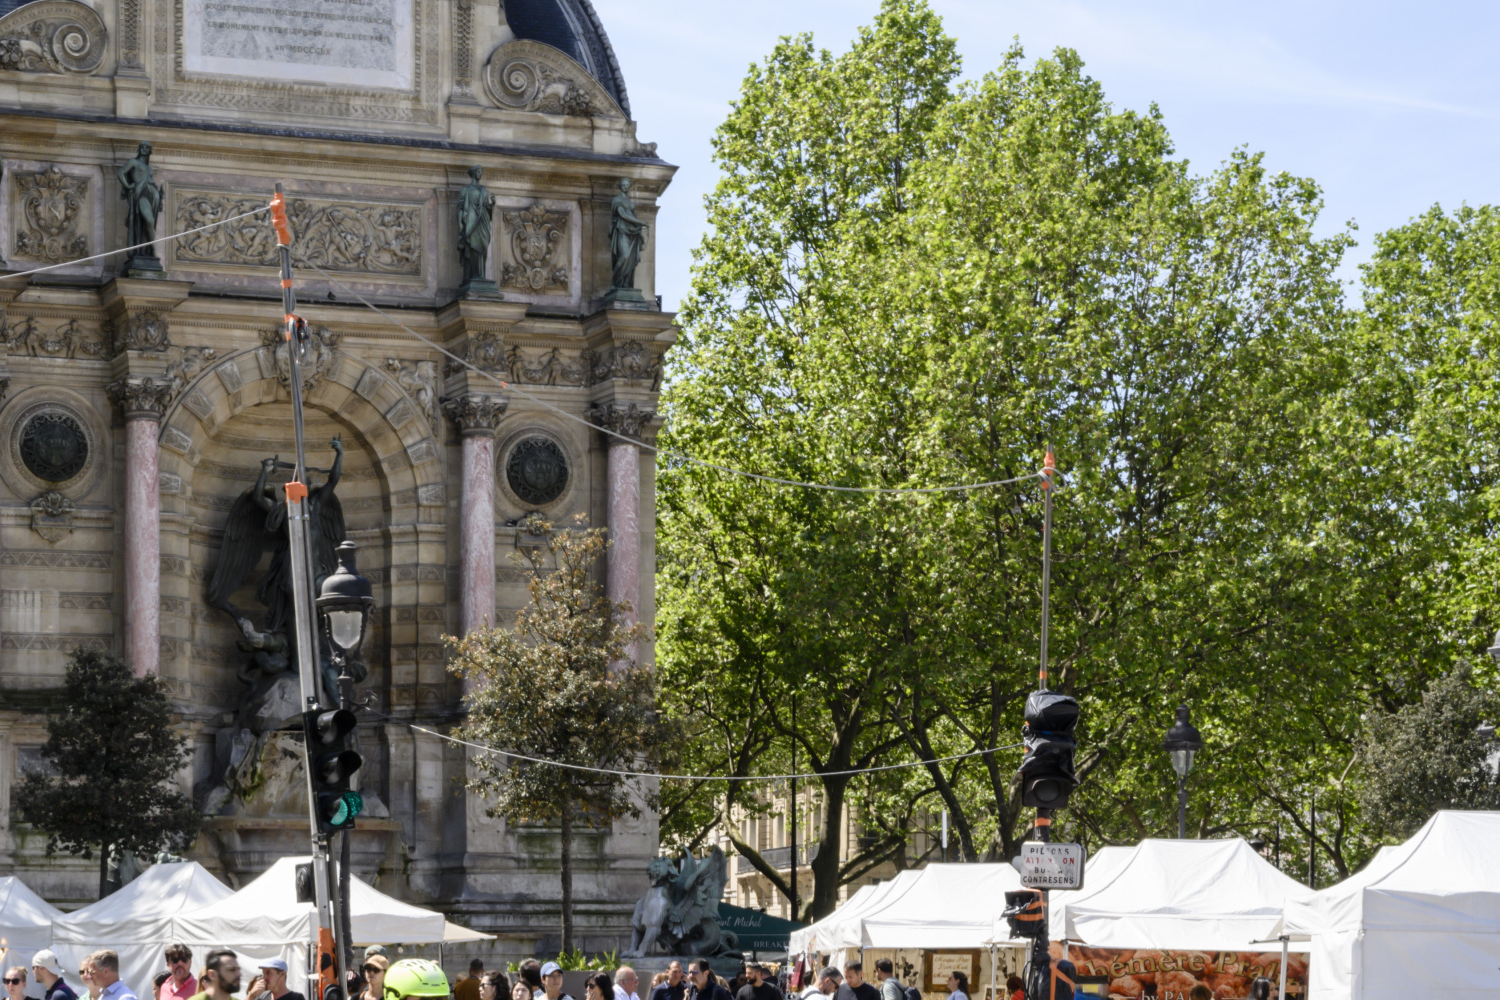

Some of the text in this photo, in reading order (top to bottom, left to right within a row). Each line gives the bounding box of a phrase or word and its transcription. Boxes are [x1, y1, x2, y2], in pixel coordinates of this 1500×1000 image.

[219, 22, 260, 31] MONUMENT
[1030, 847, 1070, 856] PIÉONS
[734, 914, 761, 927] Michel
